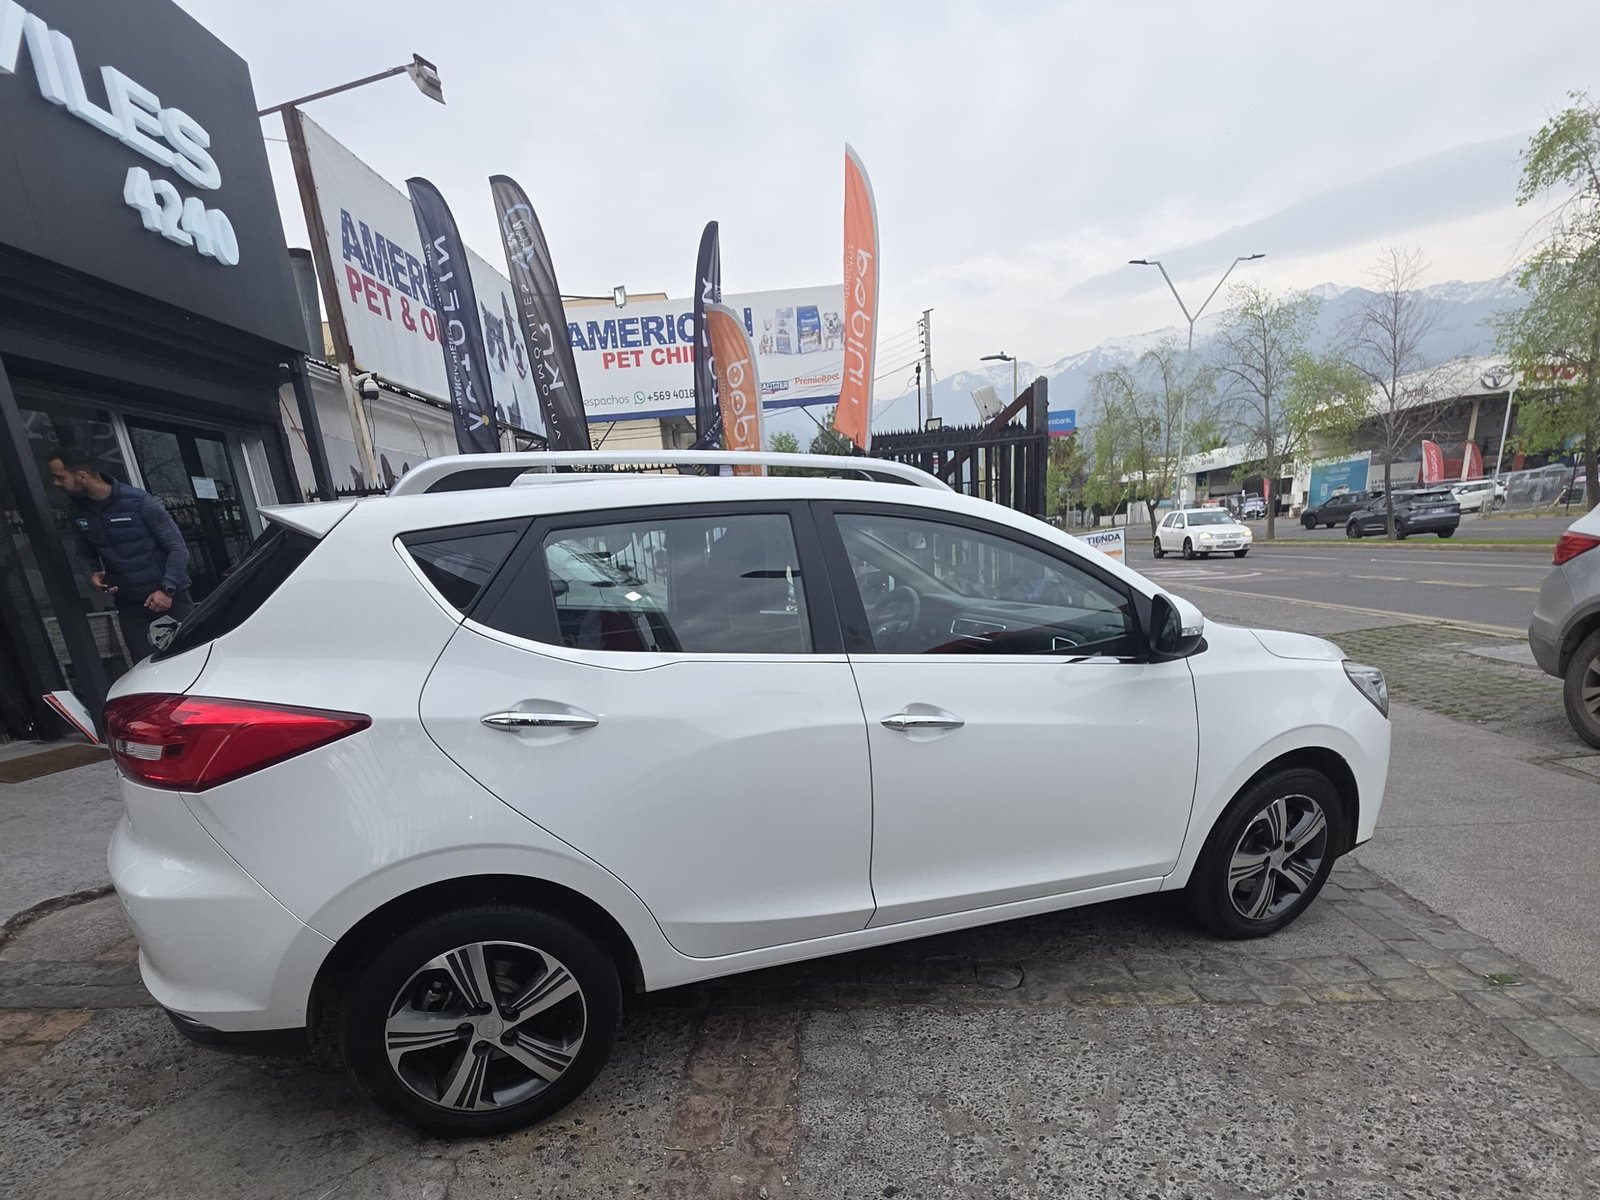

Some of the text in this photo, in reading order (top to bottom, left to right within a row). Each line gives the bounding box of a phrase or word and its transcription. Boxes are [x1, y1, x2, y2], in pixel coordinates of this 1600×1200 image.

[123, 166, 240, 266] 4240
[345, 263, 392, 321] PET
[400, 296, 417, 333] &
[602, 350, 644, 369] PET
[647, 390, 671, 401] +569
[1086, 533, 1121, 545] TIENDA
